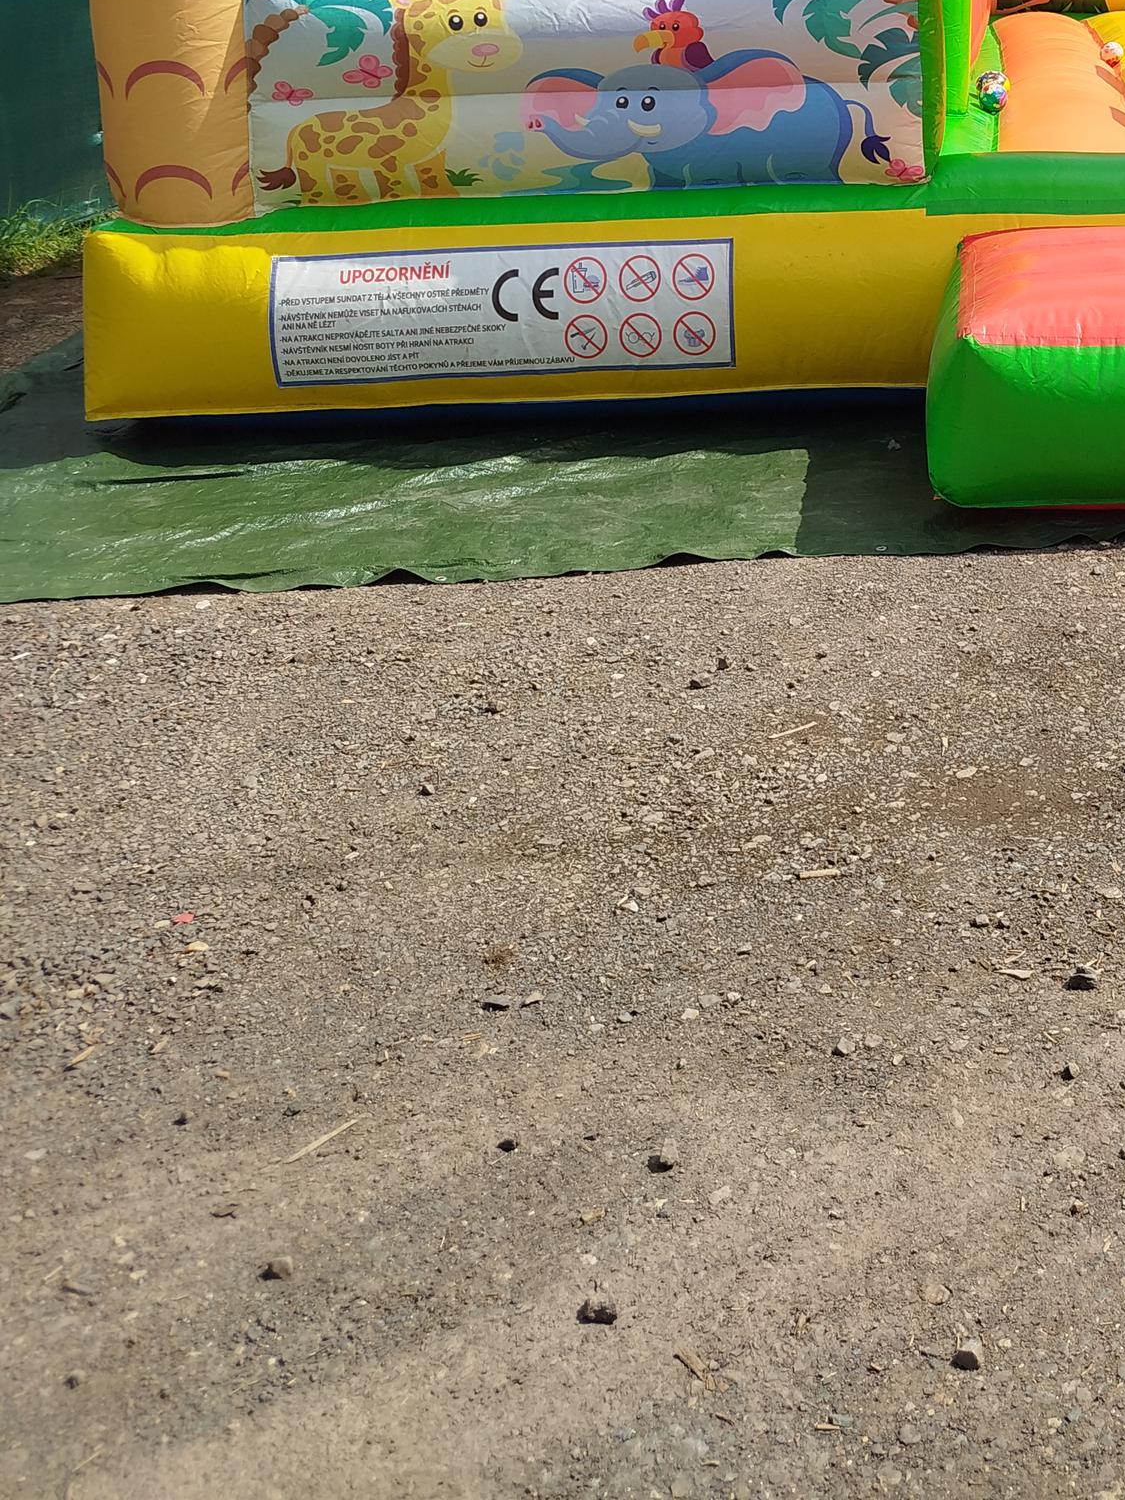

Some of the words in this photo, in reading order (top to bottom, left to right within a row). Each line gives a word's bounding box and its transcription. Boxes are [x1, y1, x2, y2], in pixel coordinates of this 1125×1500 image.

[340, 261, 450, 284] UPOZORNĚNÍ
[302, 296, 335, 305] VSTUPEM
[337, 294, 367, 303] SUNDAT
[392, 289, 426, 300] VŠECHNY
[427, 288, 450, 298] OSTRÉ
[451, 287, 489, 297] PŘEDMĚTY
[492, 267, 560, 322] CE
[328, 309, 358, 319] NEMŮŽE
[380, 308, 391, 316] NA
[392, 304, 447, 315] NAFUKOVACÍCH
[449, 304, 481, 312] STĚNÁCH
[282, 322, 294, 330] ANI
[319, 320, 336, 328] LÉZT
[294, 334, 324, 342] ATRAKCI
[326, 330, 380, 340] NEPROVÁDĚJTE
[382, 329, 404, 337] SALTA
[405, 328, 419, 336] ANI
[419, 326, 434, 335] JINÉ
[435, 324, 481, 334] NEBEZPEČNÉ
[482, 324, 506, 332] SKOKY
[329, 343, 352, 352] NESMÍ
[353, 343, 374, 351] NOSIT
[376, 342, 394, 350] BOTY
[397, 340, 408, 348] PŘI
[409, 338, 432, 348] HRANÍ
[296, 358, 326, 366] ATRAKCI
[327, 356, 344, 364] NENÍ
[346, 355, 385, 363] DOVOLENO
[387, 353, 400, 361] JÍST
[335, 365, 388, 375] RESPEKTOVÁNÍ
[390, 364, 417, 372] TĚCHTO
[419, 360, 449, 369] POKYNŮ
[457, 359, 487, 368] PŘEJEME
[546, 356, 575, 364] ZÁBAVU
